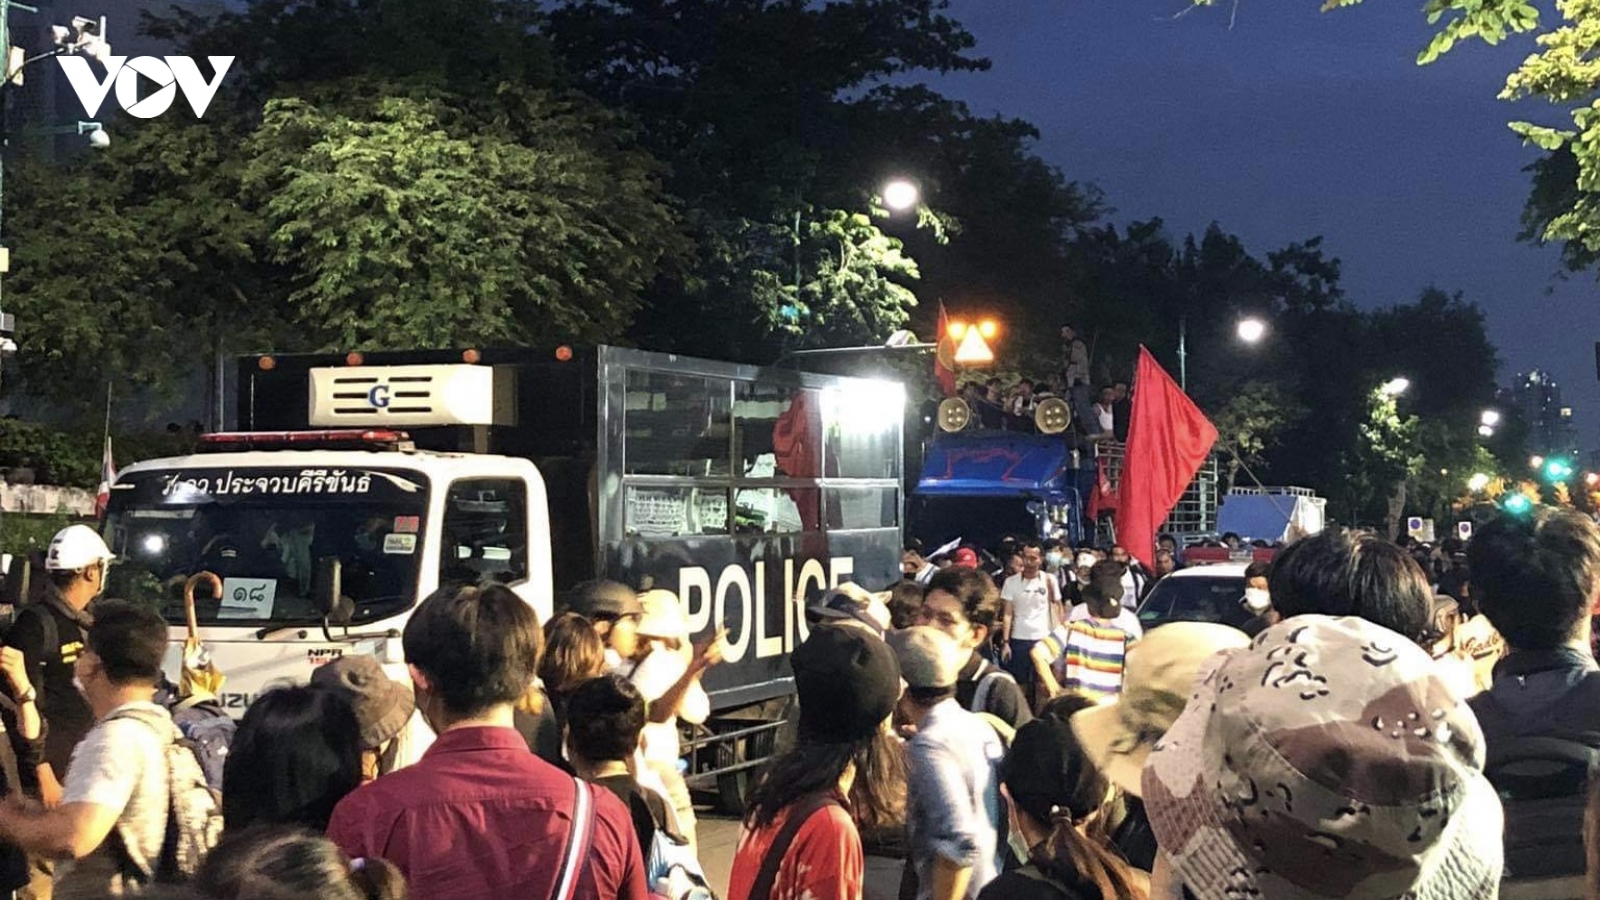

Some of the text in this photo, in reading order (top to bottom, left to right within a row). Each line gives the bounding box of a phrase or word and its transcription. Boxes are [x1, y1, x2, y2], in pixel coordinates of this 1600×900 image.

[369, 385, 390, 408] G
[233, 583, 267, 602] ๑๘
[307, 648, 343, 656] NPR
